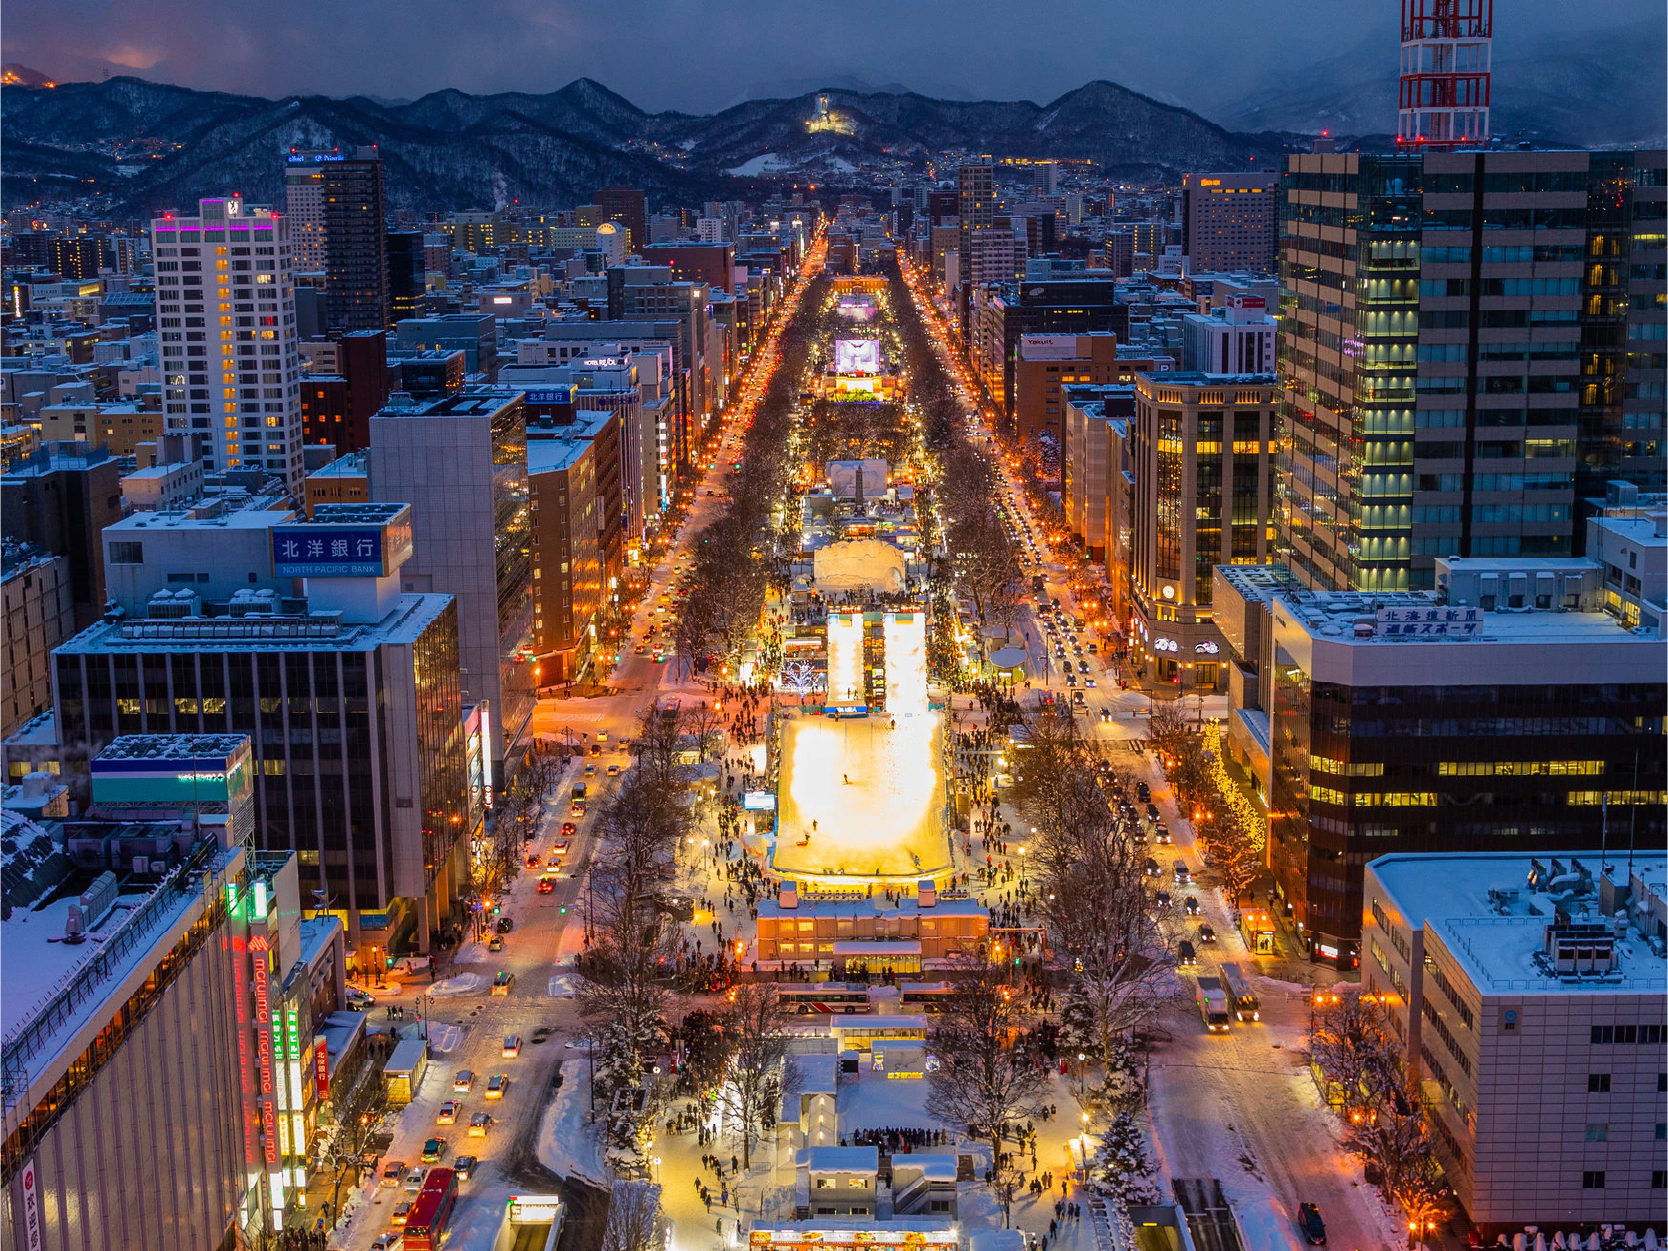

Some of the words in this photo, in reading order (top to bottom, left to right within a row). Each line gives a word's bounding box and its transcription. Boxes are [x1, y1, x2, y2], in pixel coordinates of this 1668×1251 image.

[529, 392, 563, 401] 北洋銀行
[282, 539, 373, 558] 北洋銀行
[282, 566, 312, 574] NORTH
[314, 565, 348, 573] PACIFIC
[351, 565, 375, 573] BANK
[1385, 609, 1477, 621] 北海道新聞
[1385, 622, 1477, 634] 道新スポーツ
